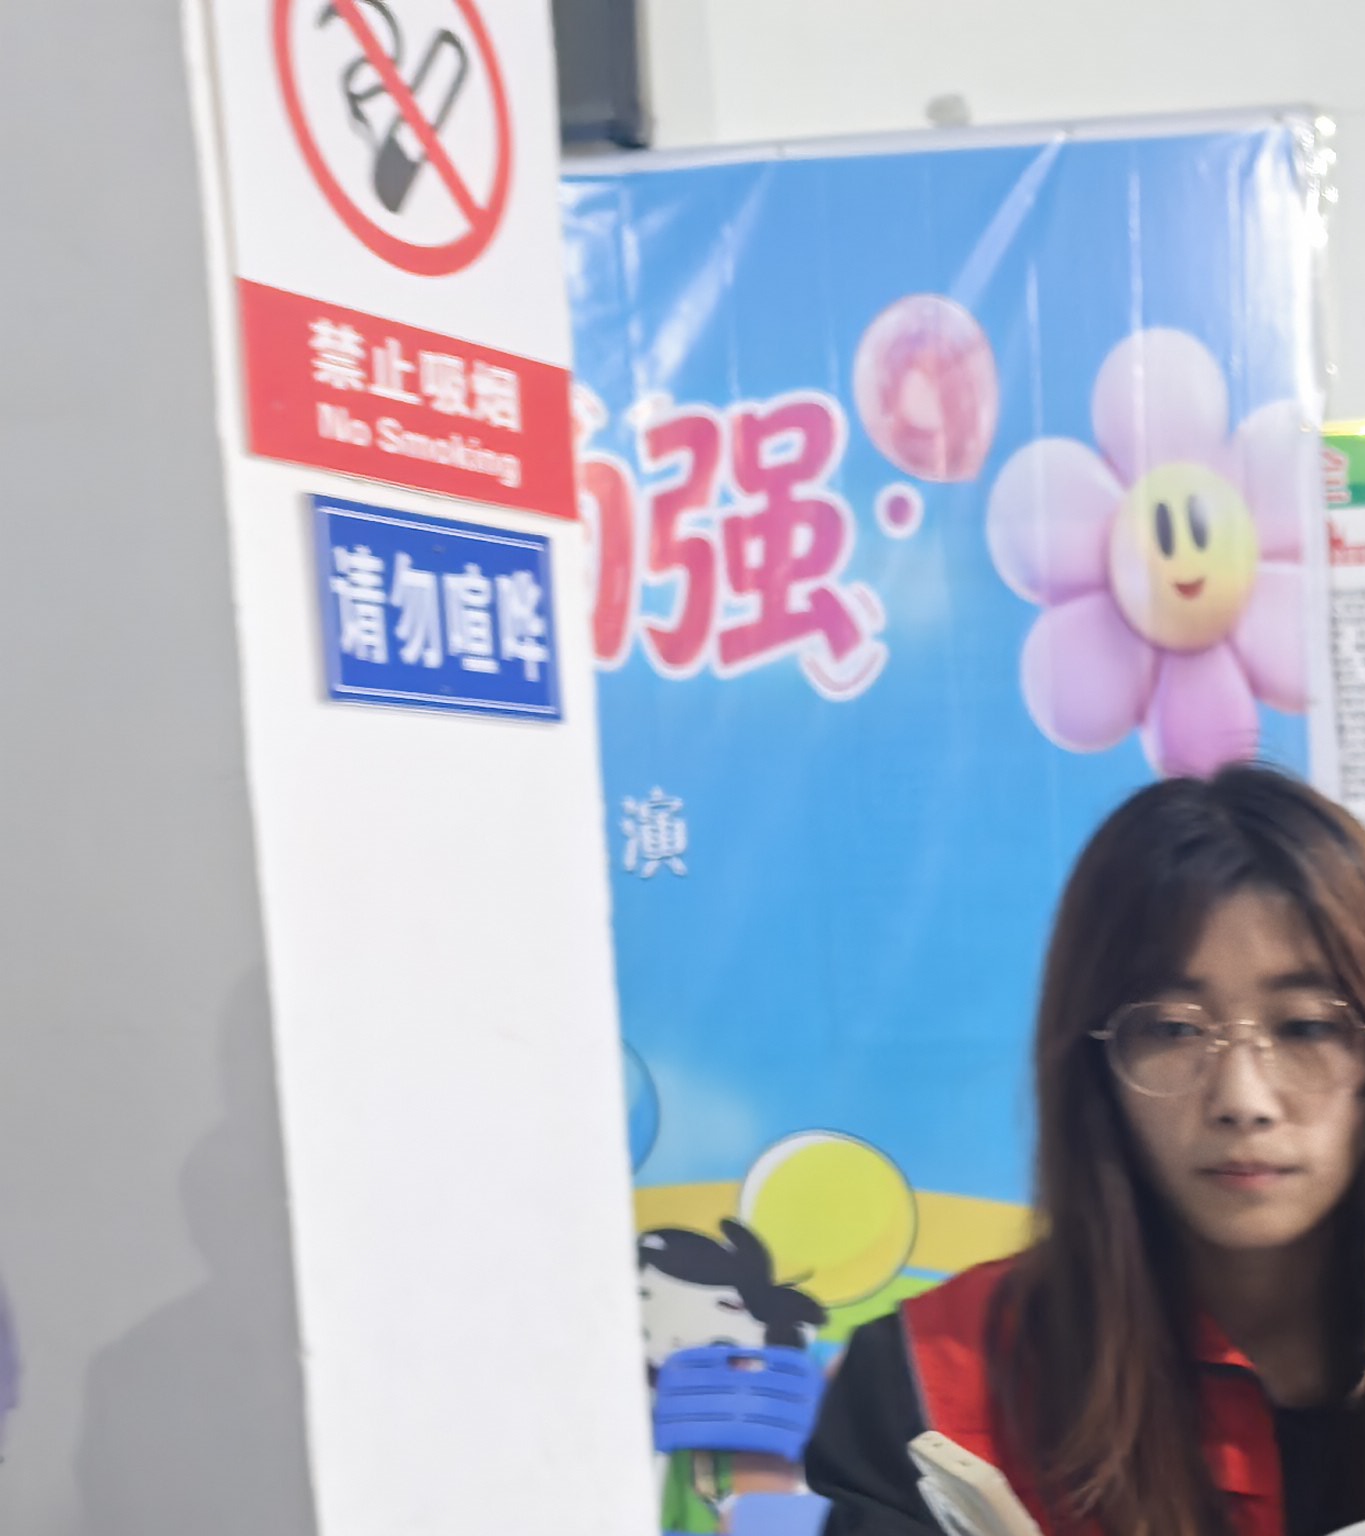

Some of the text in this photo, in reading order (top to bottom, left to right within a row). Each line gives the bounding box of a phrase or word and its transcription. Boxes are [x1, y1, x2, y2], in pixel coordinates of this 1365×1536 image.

[309, 317, 521, 432] 禁止吸烟
[317, 402, 522, 488] No Smoking
[580, 388, 868, 682] 强
[331, 544, 548, 681] 请勿喧哗
